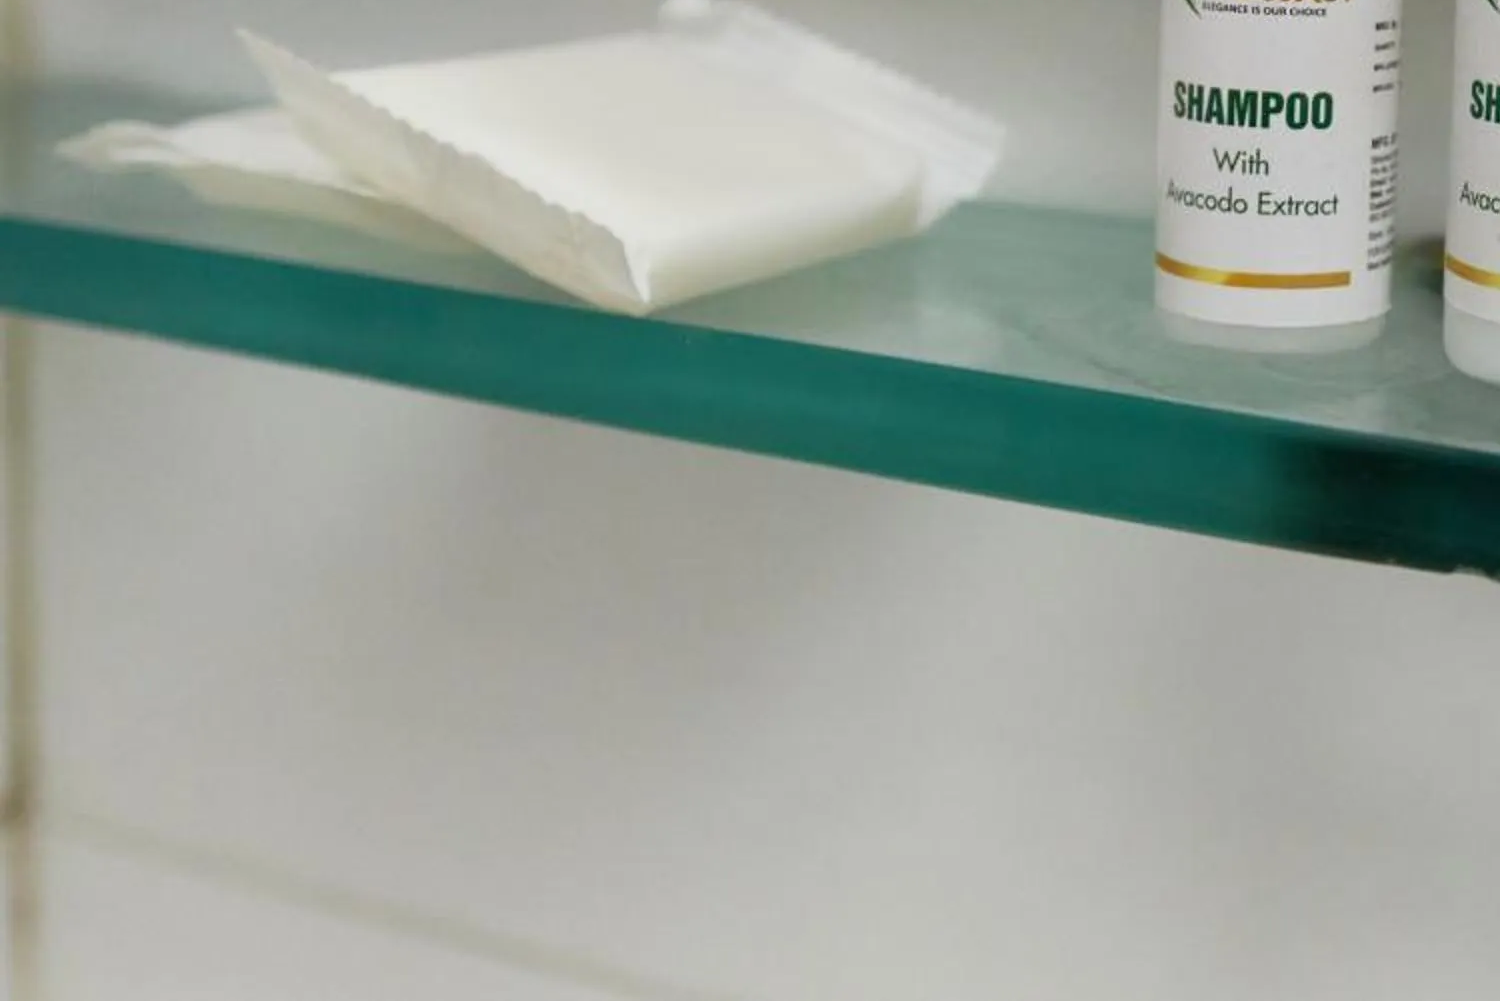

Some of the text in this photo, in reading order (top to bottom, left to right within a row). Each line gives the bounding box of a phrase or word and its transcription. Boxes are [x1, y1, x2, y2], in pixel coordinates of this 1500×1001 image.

[1202, 1, 1327, 17] ELEGANCE IS OUR CHOICE
[1173, 80, 1334, 130] SHAMPOO
[1212, 147, 1270, 176] With
[1165, 178, 1340, 217] Avacodo Extract
